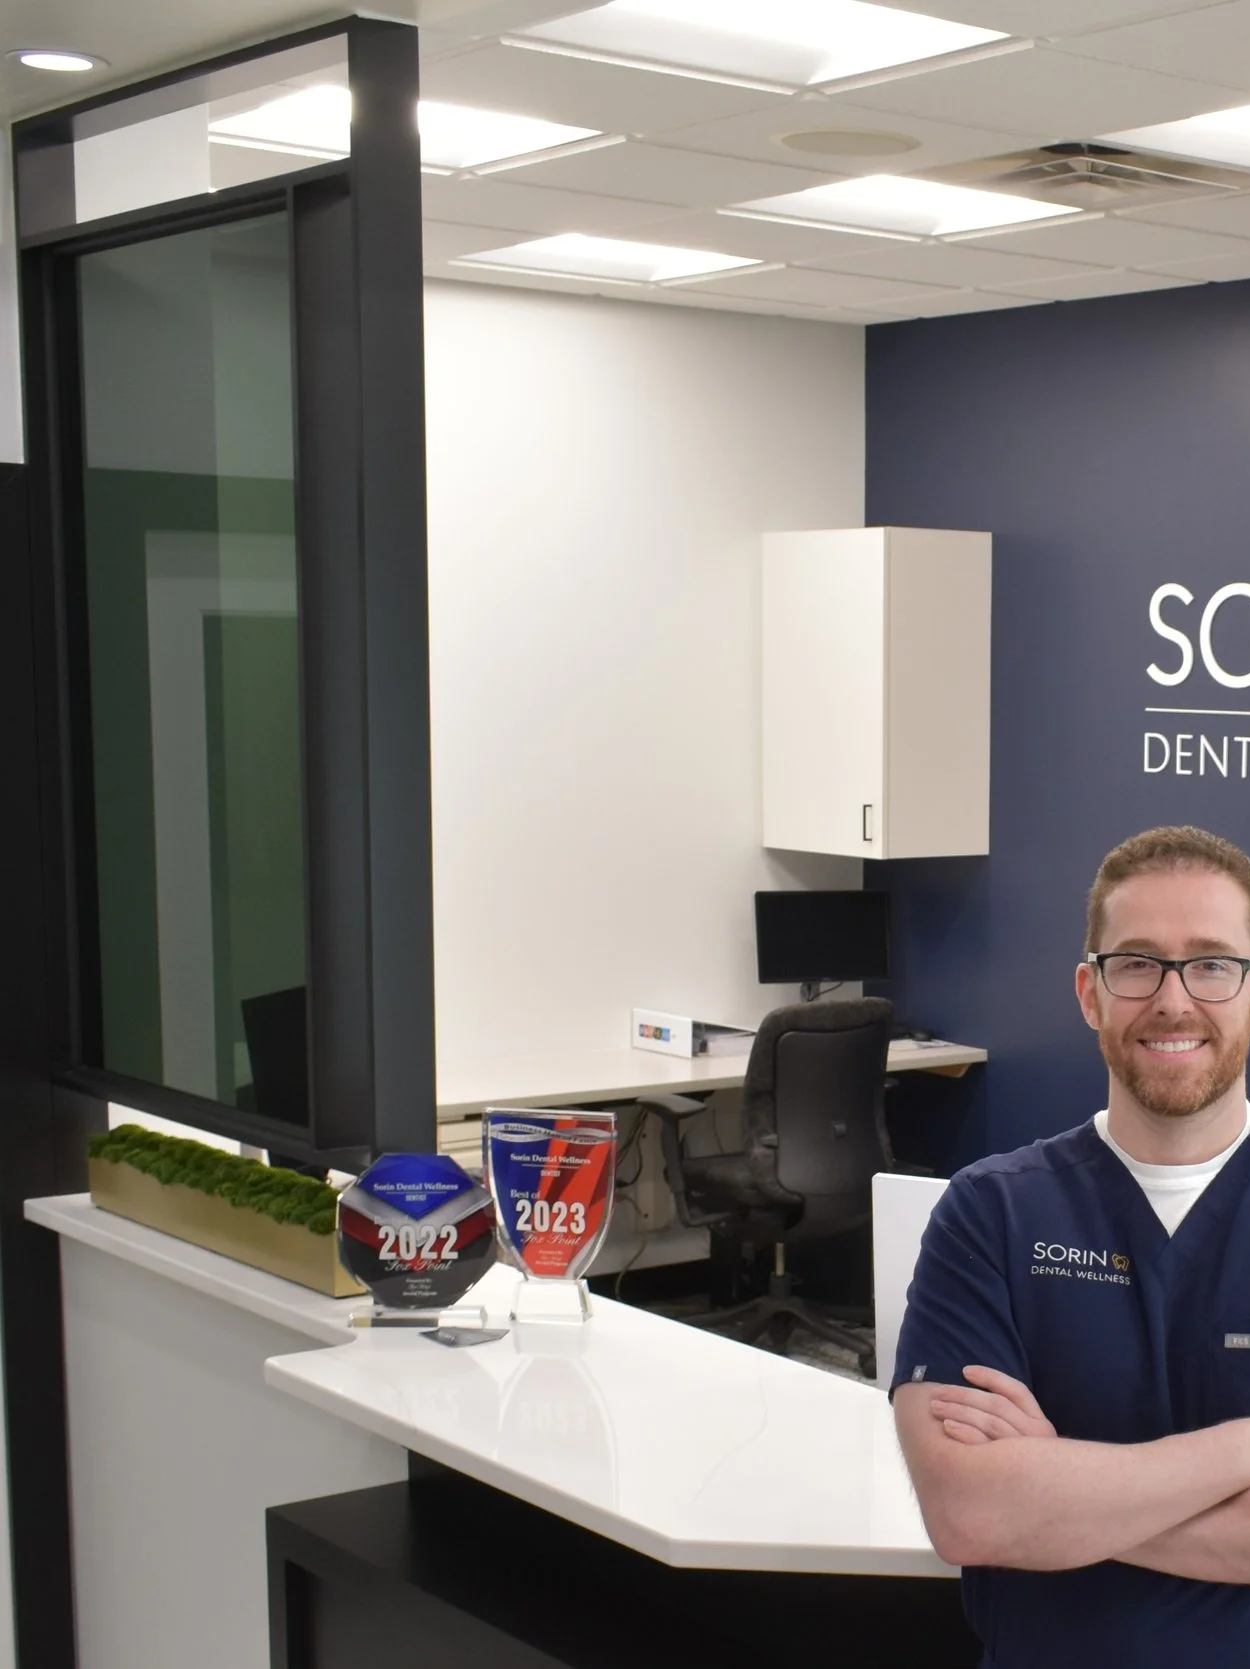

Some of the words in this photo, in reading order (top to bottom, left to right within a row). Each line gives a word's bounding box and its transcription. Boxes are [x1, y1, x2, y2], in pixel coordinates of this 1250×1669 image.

[510, 1153, 531, 1161] Sorin
[532, 1154, 557, 1163] Dental
[558, 1155, 591, 1165] Wellness
[373, 1183, 395, 1191] Sorin
[396, 1183, 423, 1191] Dental
[424, 1182, 458, 1191] Wellness
[510, 1188, 530, 1198] Best
[531, 1190, 541, 1199] of
[515, 1199, 586, 1235] 2023
[378, 1225, 459, 1261] 2022
[546, 1232, 582, 1246] Point
[1033, 1241, 1107, 1267] SORIN
[384, 1260, 412, 1272] Fox
[413, 1259, 452, 1272] Point
[1031, 1265, 1072, 1277] DENTAL
[1076, 1269, 1131, 1286] WELLNESS
